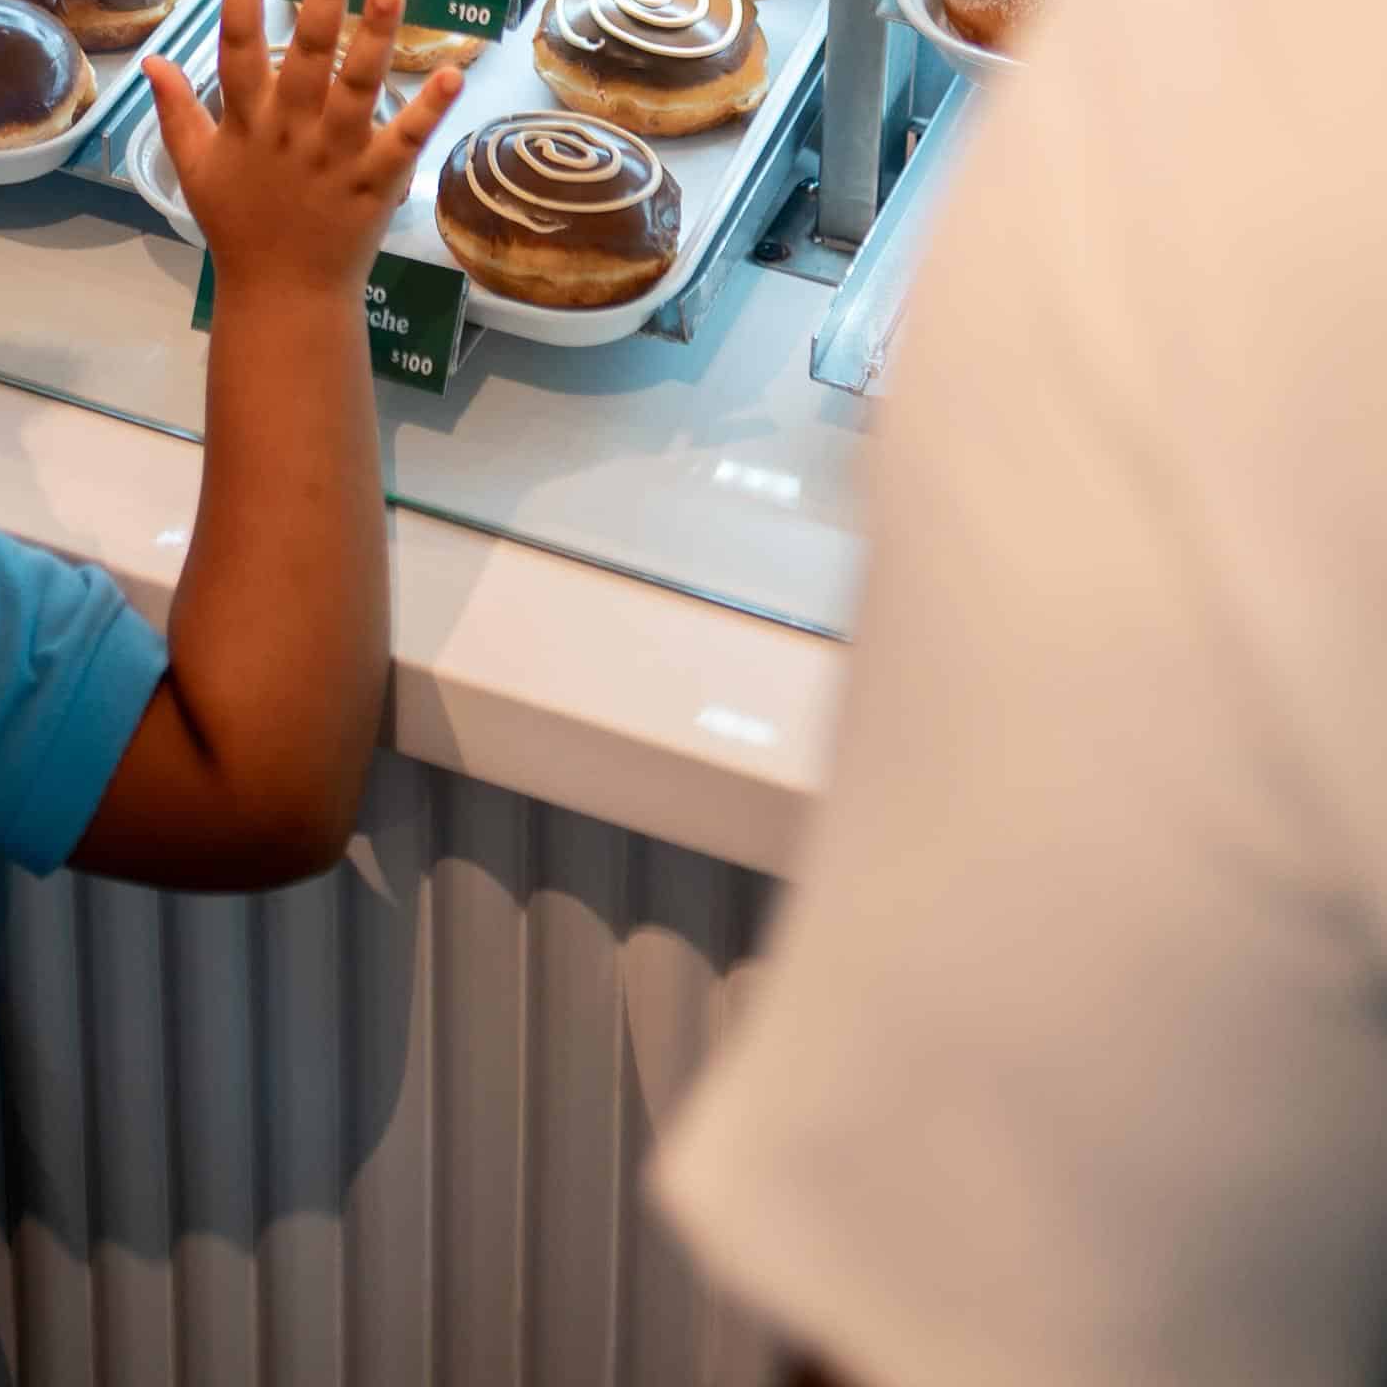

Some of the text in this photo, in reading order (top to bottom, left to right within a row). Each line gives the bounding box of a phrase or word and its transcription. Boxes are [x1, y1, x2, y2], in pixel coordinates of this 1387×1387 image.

[448, 0, 491, 26] $100
[365, 308, 410, 335] che
[391, 349, 433, 376] $100
